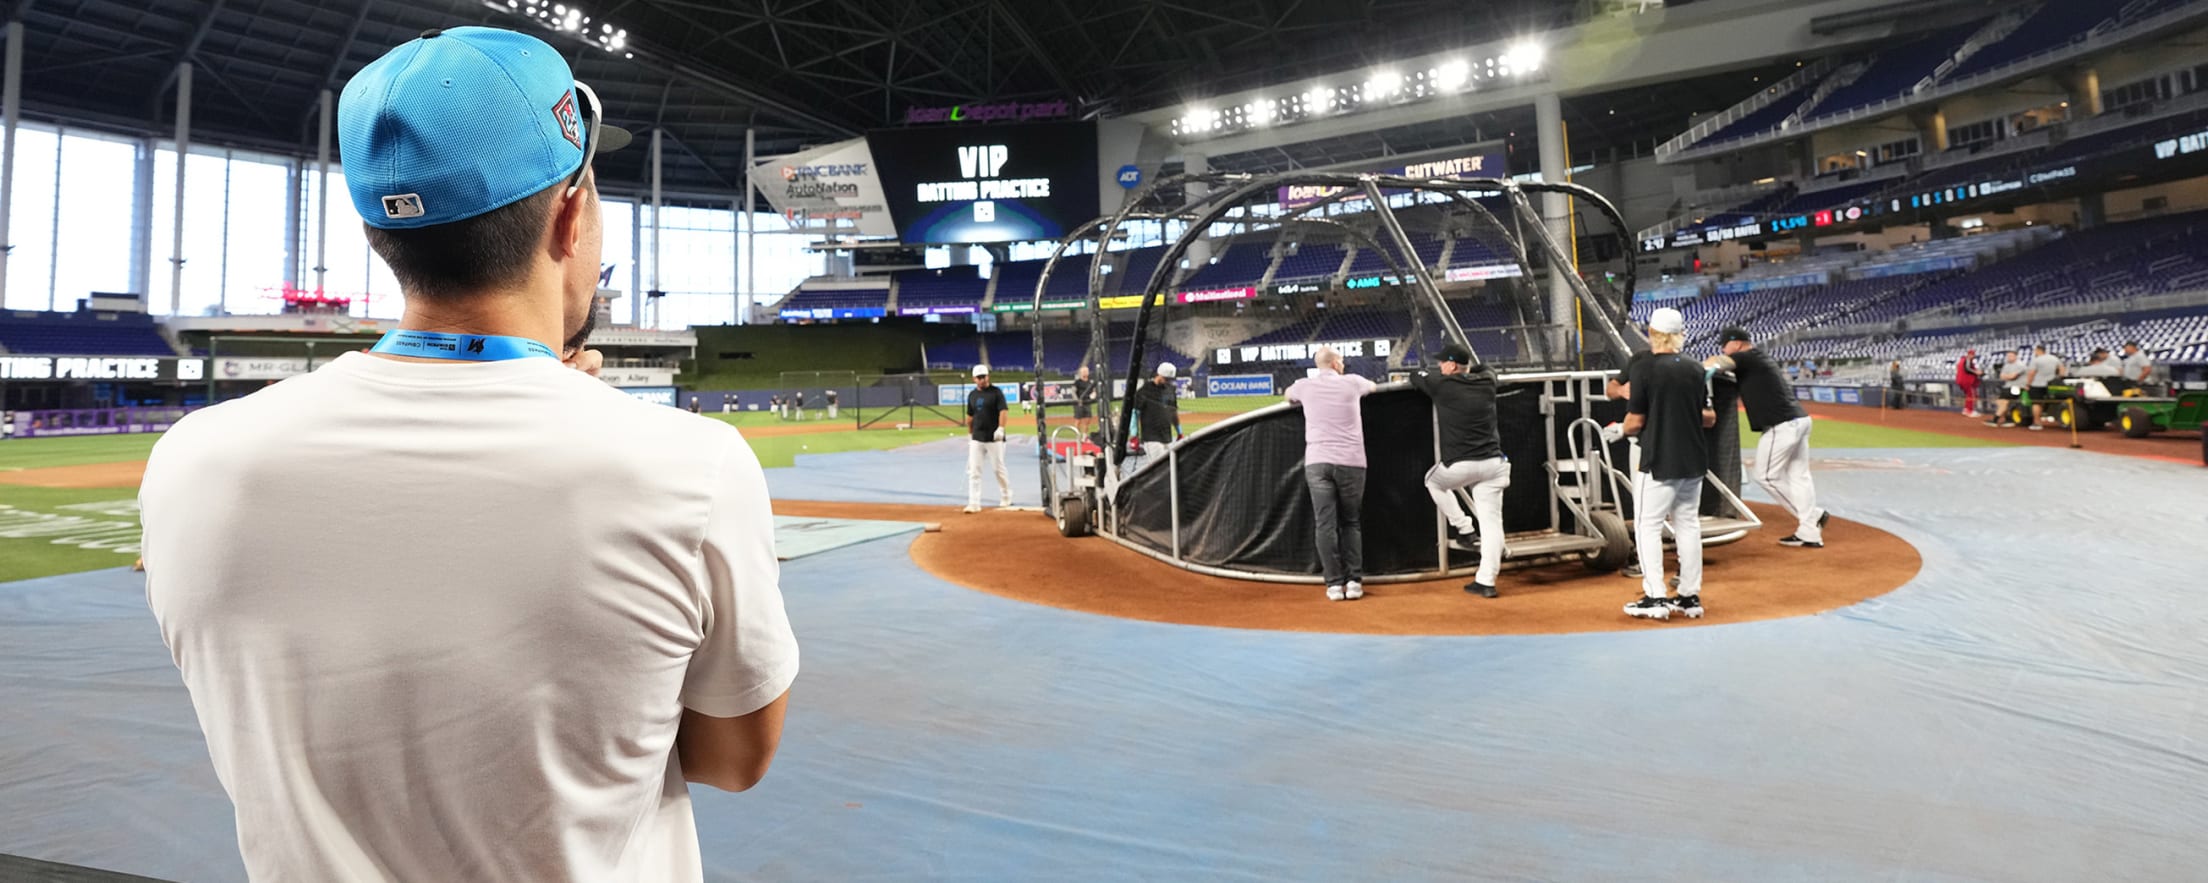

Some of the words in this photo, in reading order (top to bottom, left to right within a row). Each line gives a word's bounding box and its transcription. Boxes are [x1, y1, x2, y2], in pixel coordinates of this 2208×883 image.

[2179, 131, 2208, 154] BAT
[958, 145, 1008, 178] VIP
[1405, 156, 1483, 179] CUTWATER
[1119, 171, 1139, 182] ADT
[917, 181, 978, 202] BATTING
[980, 178, 1050, 200] PRACTICE
[1240, 346, 1259, 362] VIP
[56, 358, 159, 379] PRACTICE
[1221, 381, 1248, 391] OCEAN
[1249, 381, 1271, 390] BANK
